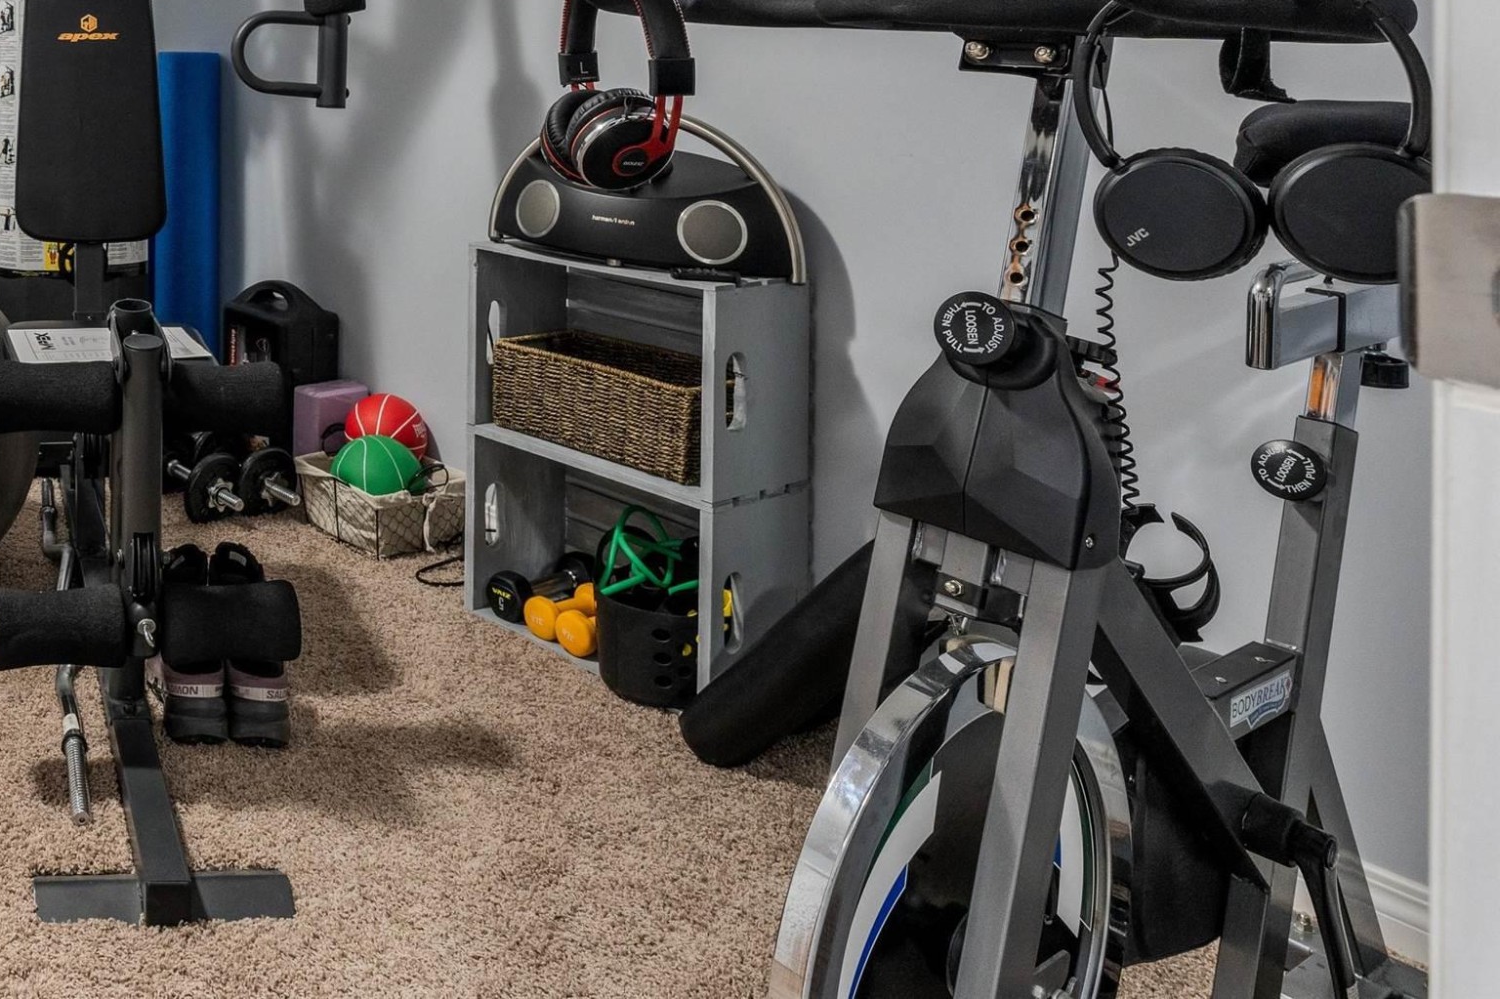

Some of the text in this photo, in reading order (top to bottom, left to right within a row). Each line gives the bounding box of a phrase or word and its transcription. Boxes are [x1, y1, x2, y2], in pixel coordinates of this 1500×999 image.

[57, 32, 120, 43] apex
[579, 61, 589, 74] L
[1126, 227, 1150, 247] JVC
[941, 303, 963, 354] THEN PULL
[965, 309, 979, 345] LOOSEN
[981, 301, 1005, 354] TO ADJUST
[1257, 445, 1287, 481] TO ADJUST
[1274, 455, 1298, 482] LOOSEN
[1285, 457, 1316, 493] THEN PULL
